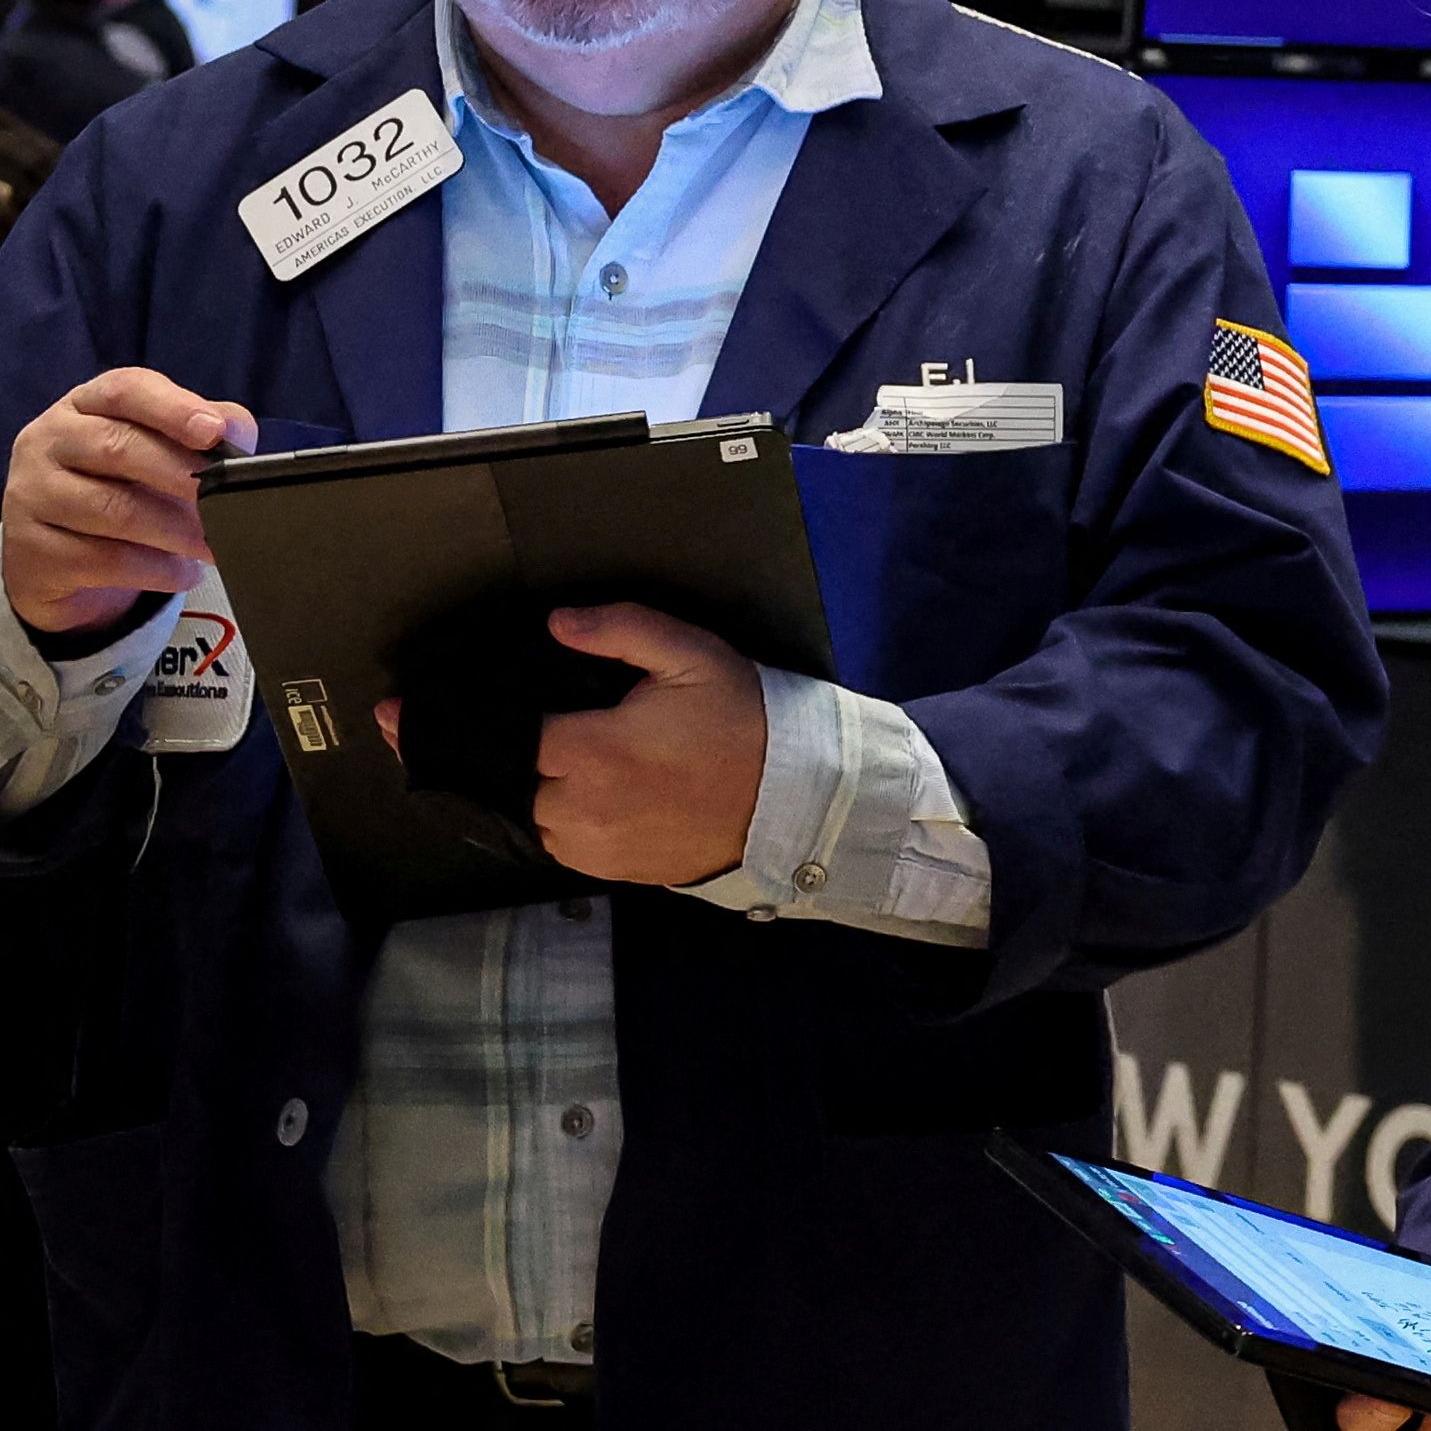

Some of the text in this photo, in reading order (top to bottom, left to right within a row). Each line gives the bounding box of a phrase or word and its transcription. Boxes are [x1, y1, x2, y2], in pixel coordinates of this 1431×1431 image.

[272, 117, 415, 221] 1032
[275, 140, 441, 254] EDWARD J. McCARTHY
[293, 226, 350, 268] AMERICAS
[420, 165, 442, 185] LLC
